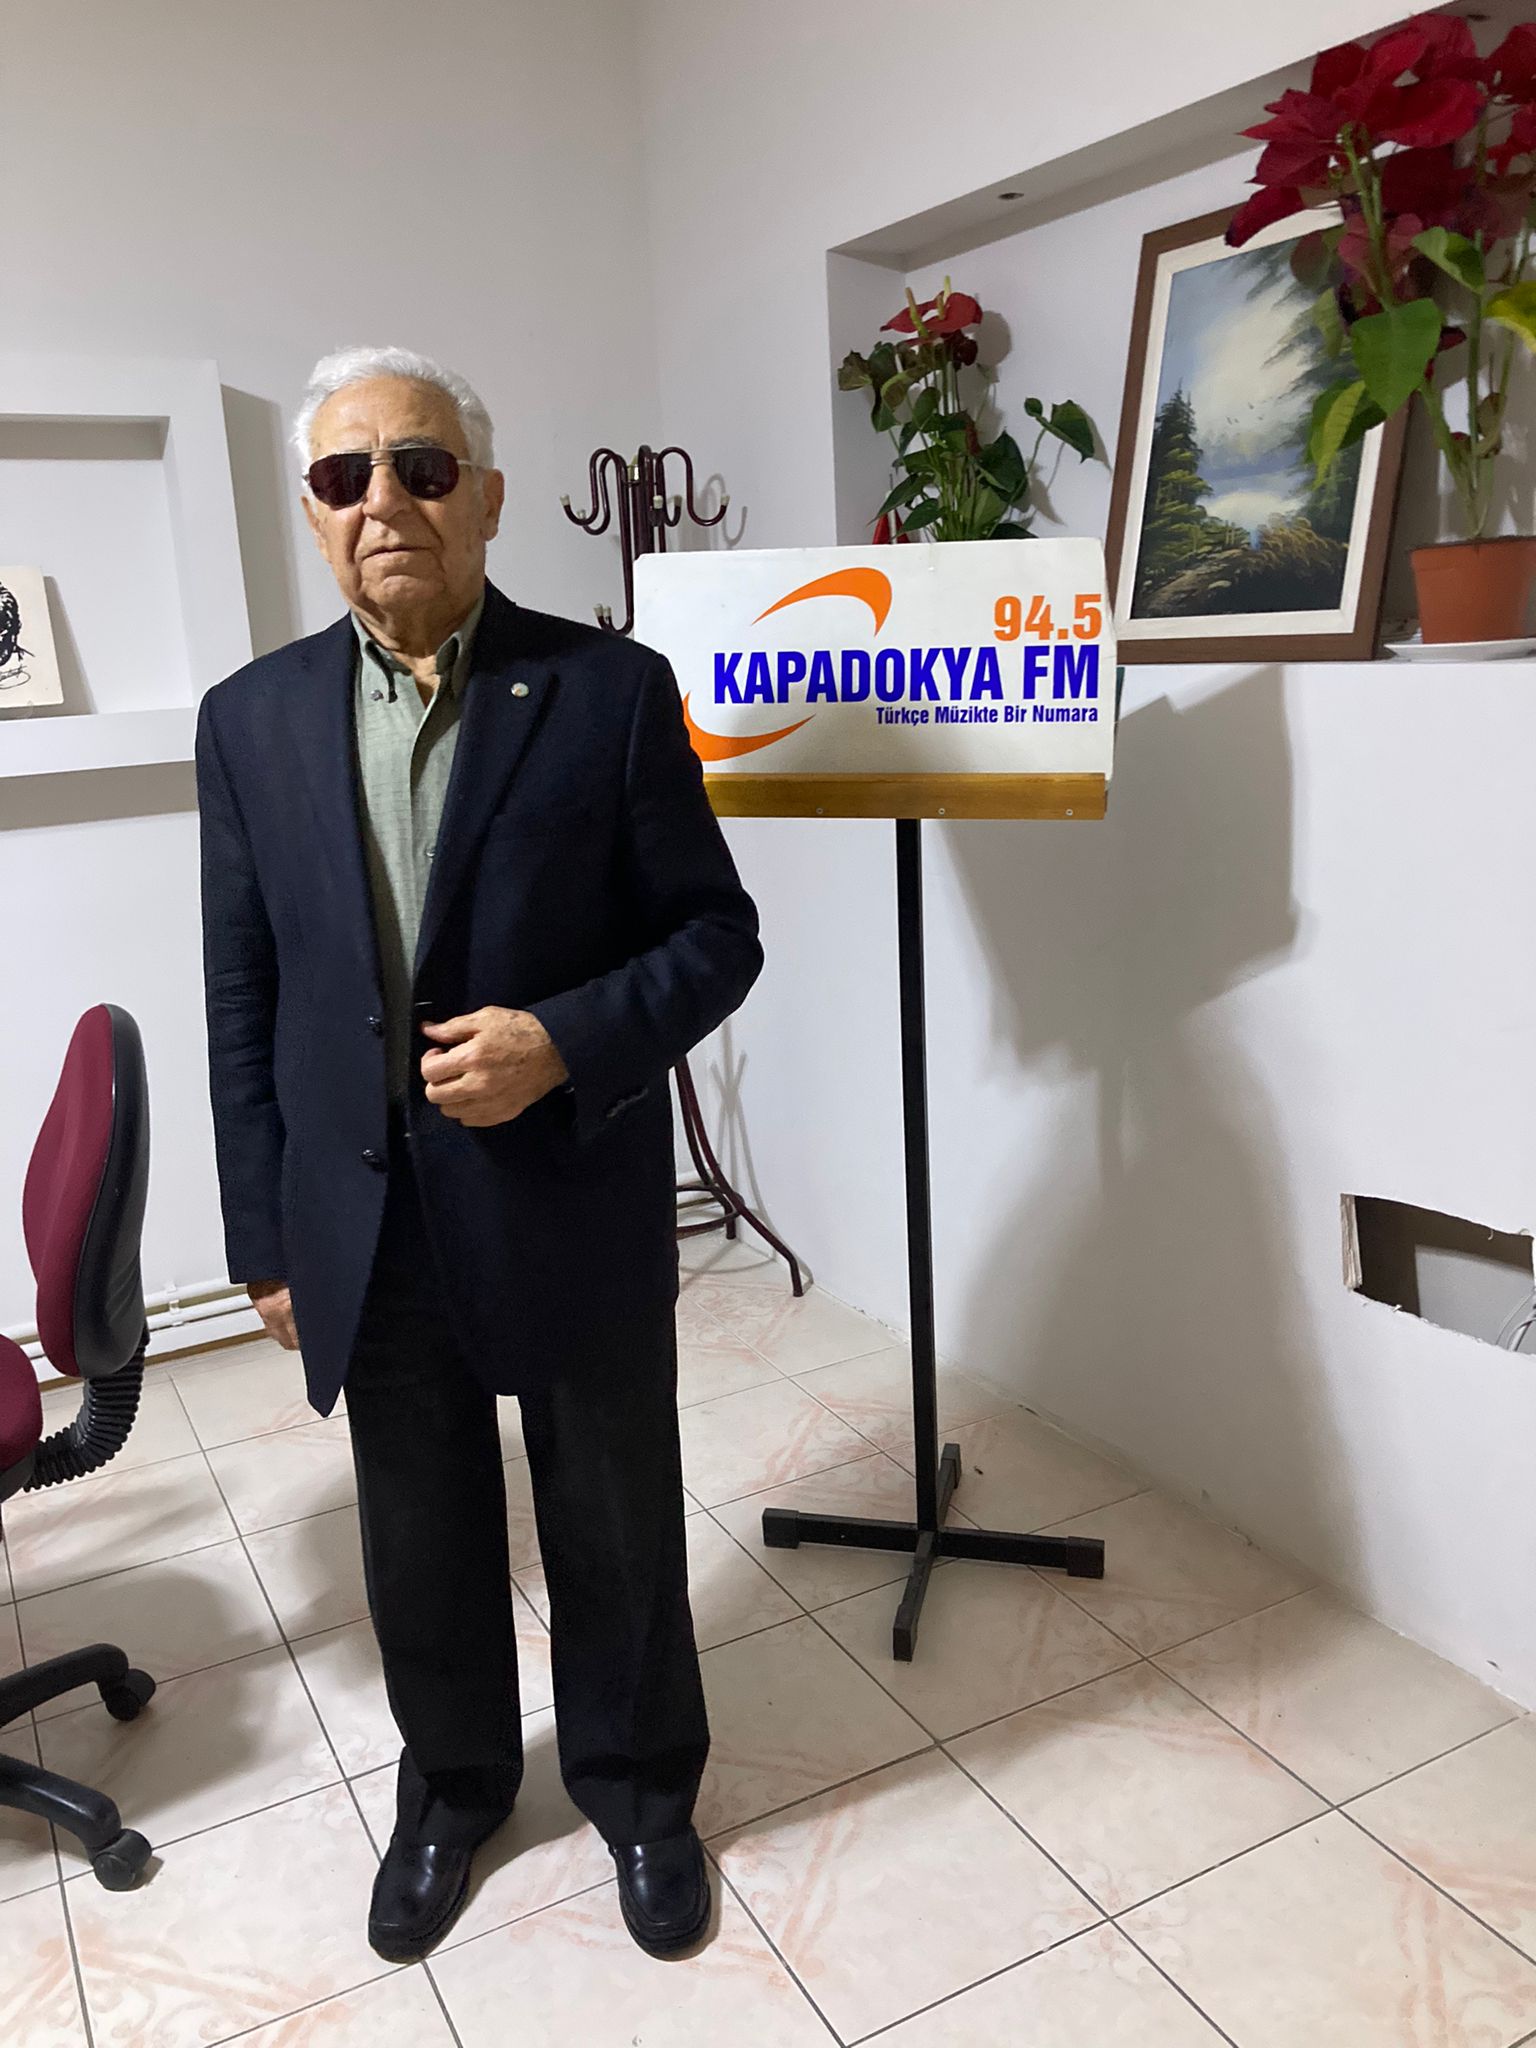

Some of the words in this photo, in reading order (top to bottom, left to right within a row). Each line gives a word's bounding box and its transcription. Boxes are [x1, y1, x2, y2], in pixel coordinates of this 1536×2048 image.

[994, 593, 1102, 642] 94.5
[714, 646, 1004, 705] KAPADOKYA
[1022, 644, 1100, 700] FM
[876, 707, 929, 726] Türkçe
[934, 705, 998, 724] Müzikte
[1003, 705, 1027, 723] Bir
[1032, 704, 1099, 723] Numara
